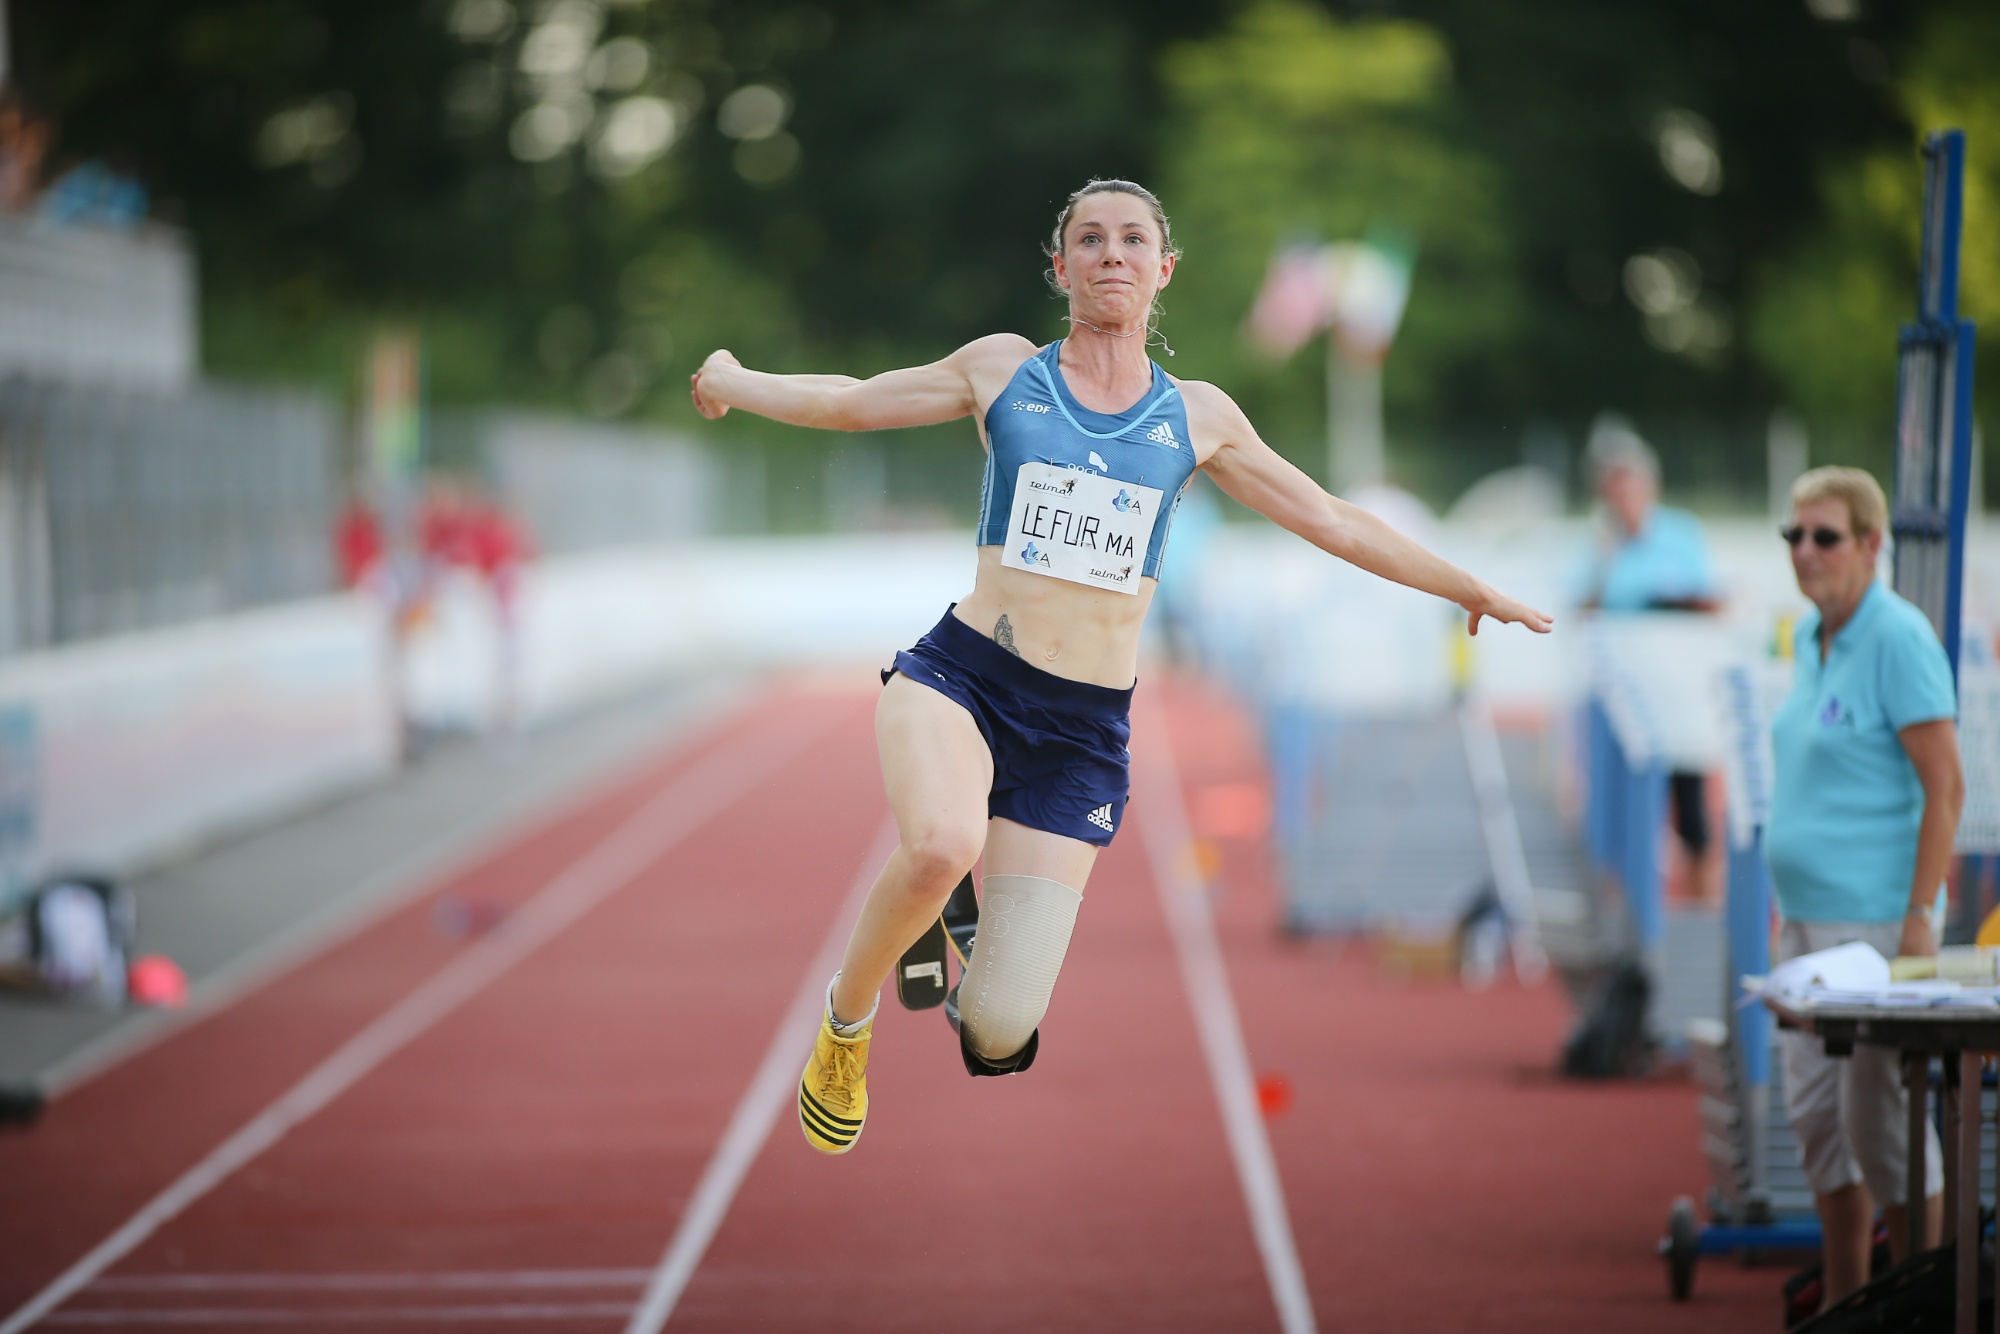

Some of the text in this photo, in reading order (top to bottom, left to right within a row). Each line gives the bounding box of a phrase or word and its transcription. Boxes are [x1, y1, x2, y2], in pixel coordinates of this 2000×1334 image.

[1147, 432, 1180, 450] adidas
[1021, 503, 1049, 539] LE
[1049, 509, 1101, 550] FUR
[1087, 814, 1114, 833] adidas
